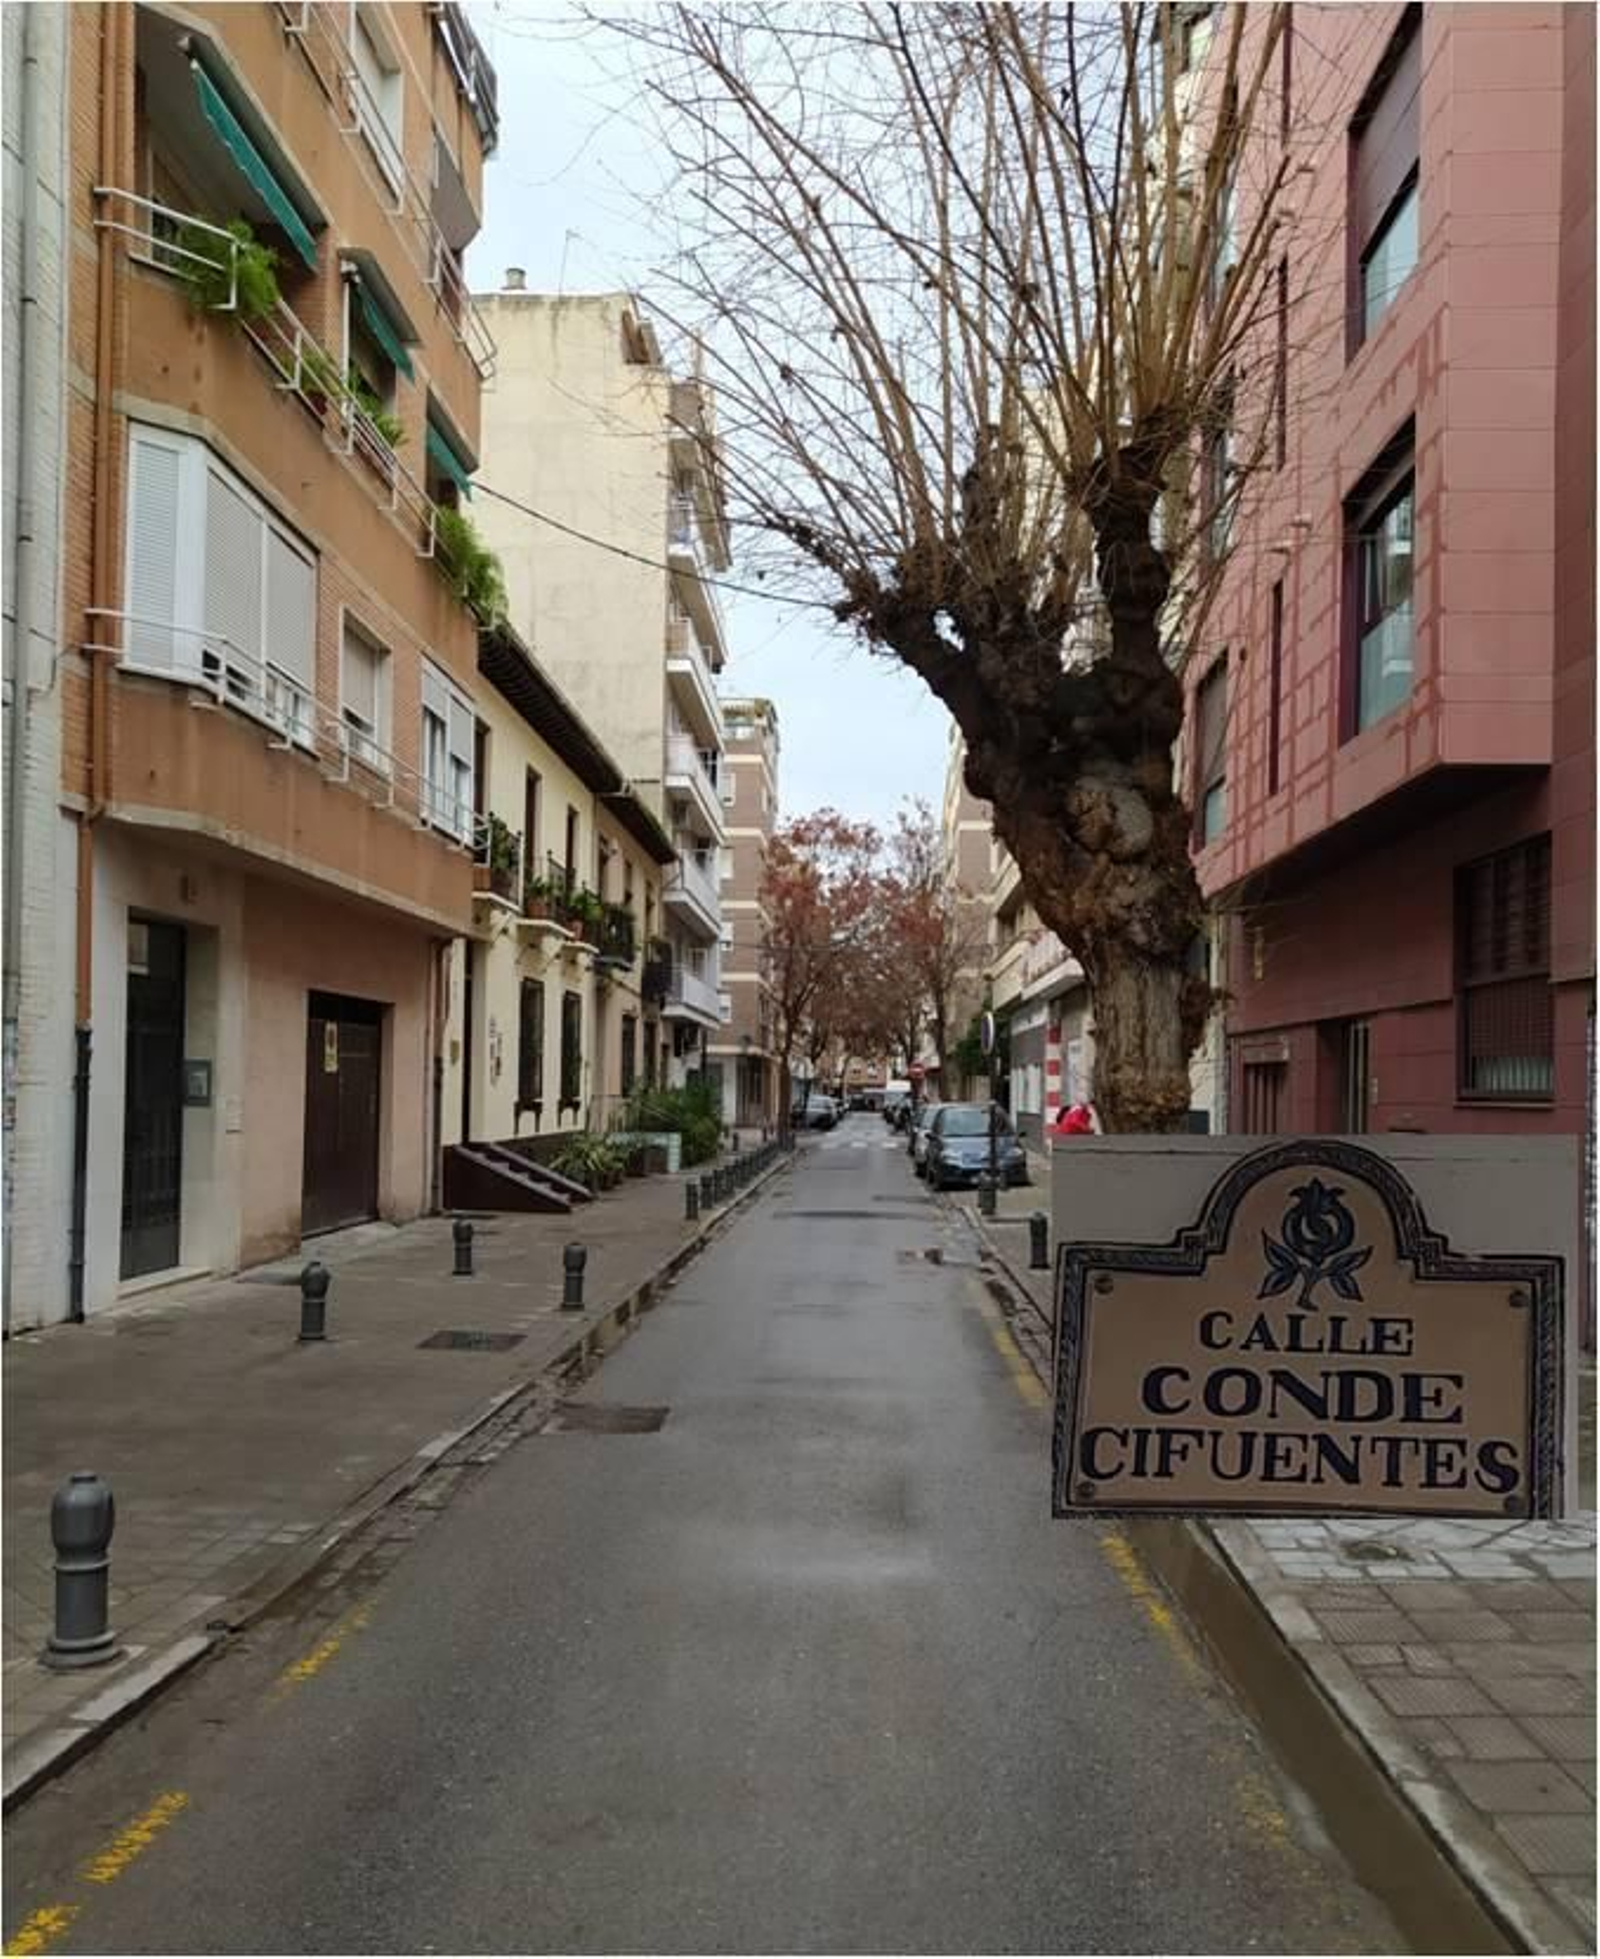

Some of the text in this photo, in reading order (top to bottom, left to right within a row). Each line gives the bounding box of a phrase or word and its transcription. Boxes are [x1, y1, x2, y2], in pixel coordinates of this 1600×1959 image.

[1200, 1310, 1414, 1357] CALLE
[1141, 1365, 1464, 1425] CONDE
[1078, 1425, 1521, 1495] CIFUENTES
